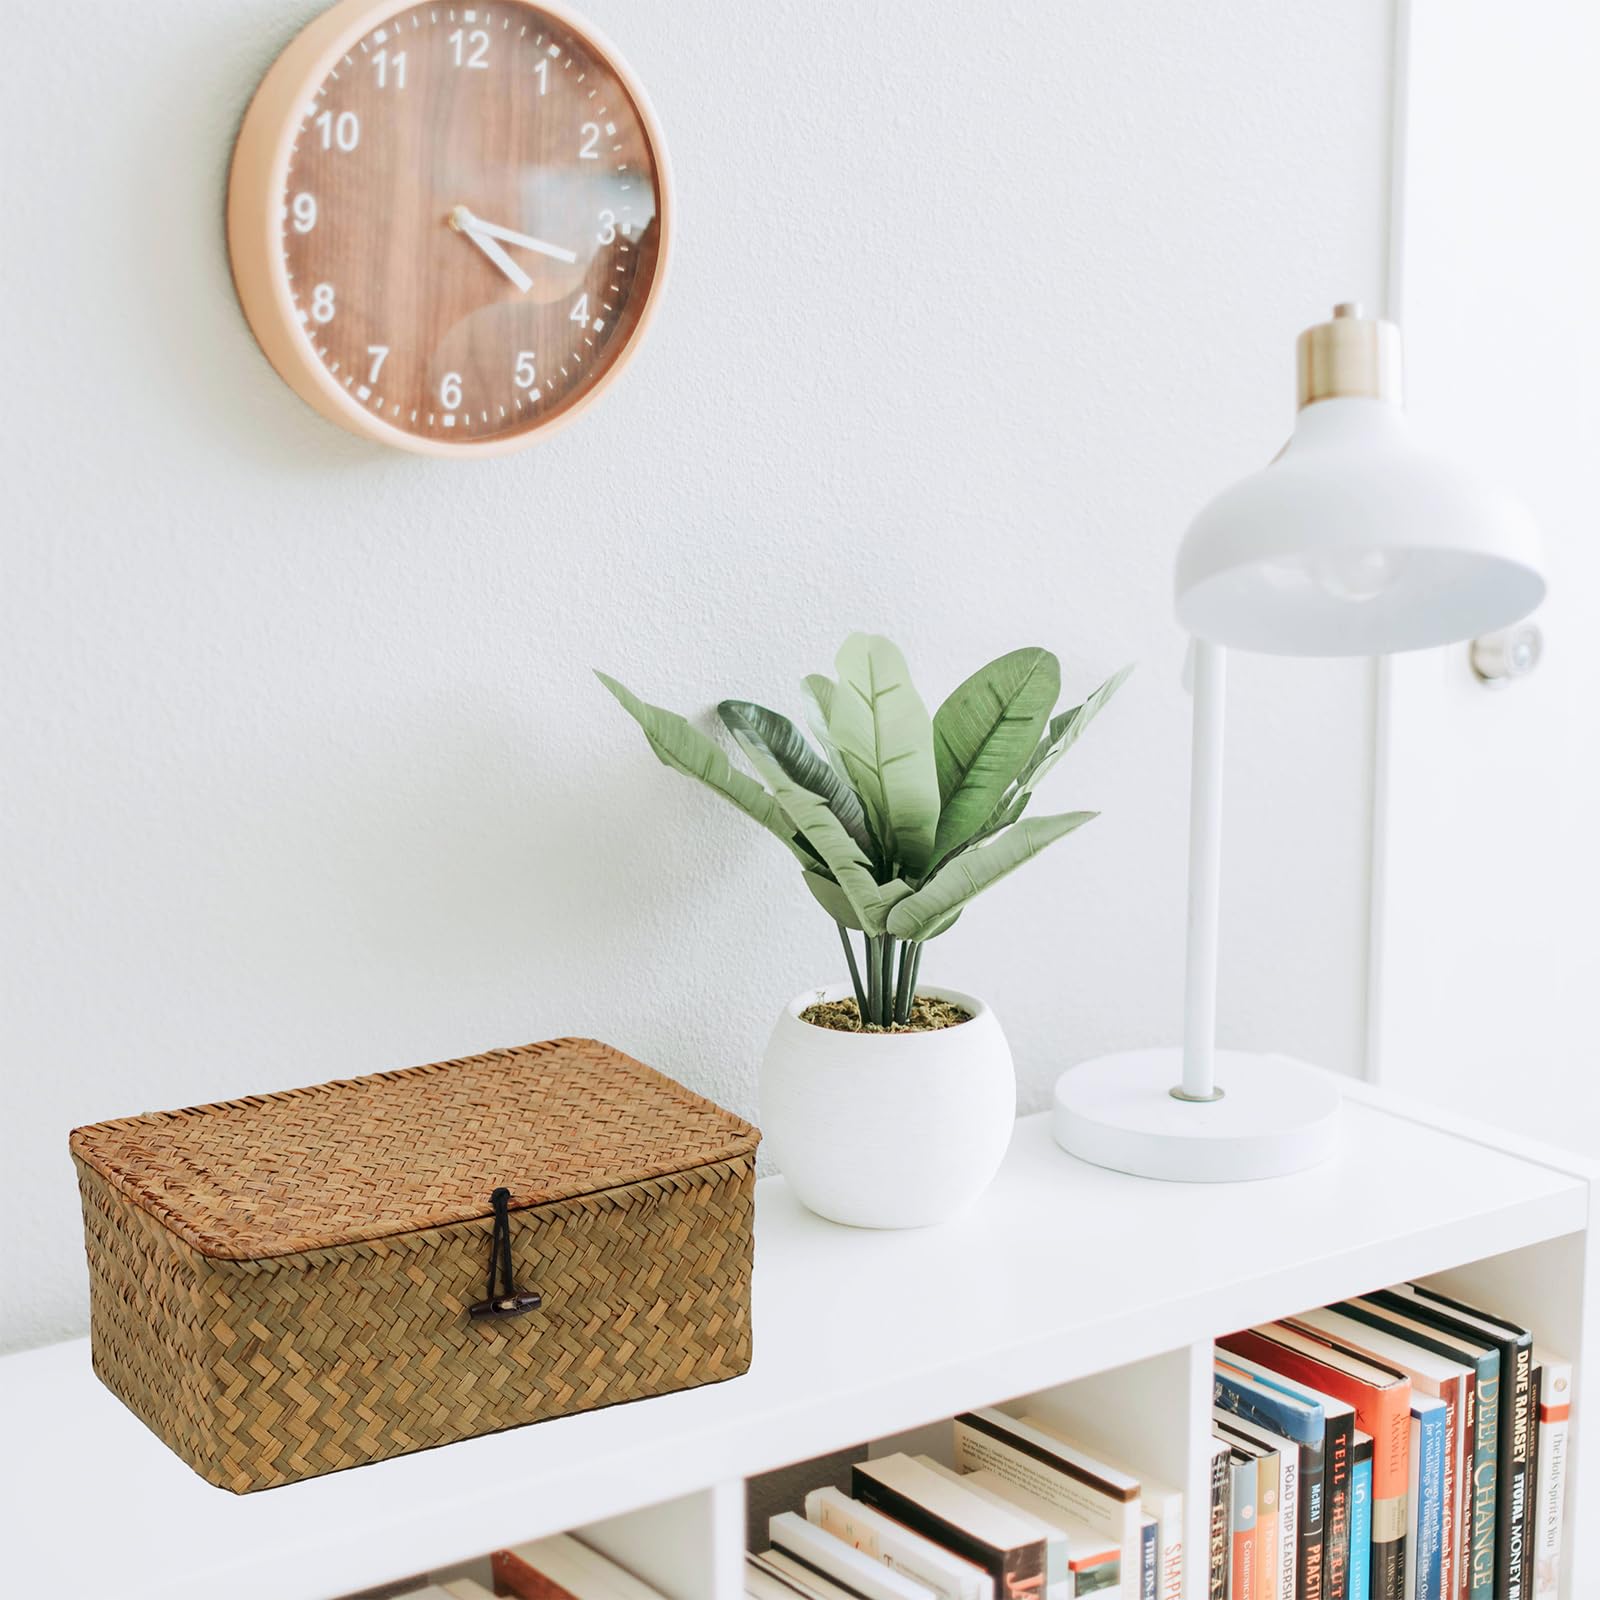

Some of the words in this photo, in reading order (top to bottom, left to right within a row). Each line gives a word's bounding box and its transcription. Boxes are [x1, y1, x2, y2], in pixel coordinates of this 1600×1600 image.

[449, 29, 489, 69] 12
[372, 50, 407, 89] 11
[534, 59, 549, 95] 1
[316, 112, 359, 151] 10
[579, 123, 599, 159] 2
[293, 194, 317, 232] 9
[597, 211, 615, 245] 3
[312, 285, 335, 323] 8
[570, 294, 590, 328] 4
[367, 347, 390, 383] 7
[515, 352, 535, 388] 5
[440, 373, 462, 409] 6
[1516, 1350, 1529, 1393] DAVE
[1424, 1423, 1434, 1435] for
[1435, 1421, 1442, 1429] A
[1446, 1404, 1454, 1425] The
[1478, 1376, 1498, 1452] DEEP
[1513, 1396, 1527, 1462] RAMSEY
[1390, 1414, 1400, 1476] MAXWELL
[1445, 1428, 1453, 1453] Nuts
[1553, 1432, 1564, 1454] The
[1334, 1434, 1346, 1484] TELL
[1424, 1438, 1434, 1485] Weddings
[1432, 1430, 1441, 1497] Contemporary
[1444, 1456, 1452, 1475] and
[1549, 1456, 1561, 1482] Holy
[1285, 1465, 1294, 1501] ROAD
[1354, 1482, 1366, 1503] 5
[1425, 1488, 1433, 1497] &
[1444, 1478, 1452, 1504] Bolts
[1547, 1484, 1559, 1515] Spirit
[1284, 1502, 1294, 1532] TRIP
[1311, 1483, 1321, 1522] McNEAL
[1333, 1492, 1344, 1534] THE
[1443, 1506, 1450, 1516] of
[1512, 1481, 1524, 1522] TOTAL
[1212, 1504, 1224, 1568] LIKE
[1431, 1502, 1440, 1552] Handbook
[1442, 1517, 1451, 1556] Church
[1473, 1460, 1496, 1588] CHANGE
[1547, 1527, 1557, 1547] You
[1548, 1517, 1557, 1525] &
[1146, 1537, 1154, 1568] THE
[1282, 1535, 1293, 1600] LEADERSH
[1387, 1555, 1395, 1583] LAWS
[1510, 1526, 1522, 1582] MONEY
[1212, 1578, 1222, 1592] A
[1306, 1544, 1321, 1600] PRACTI
